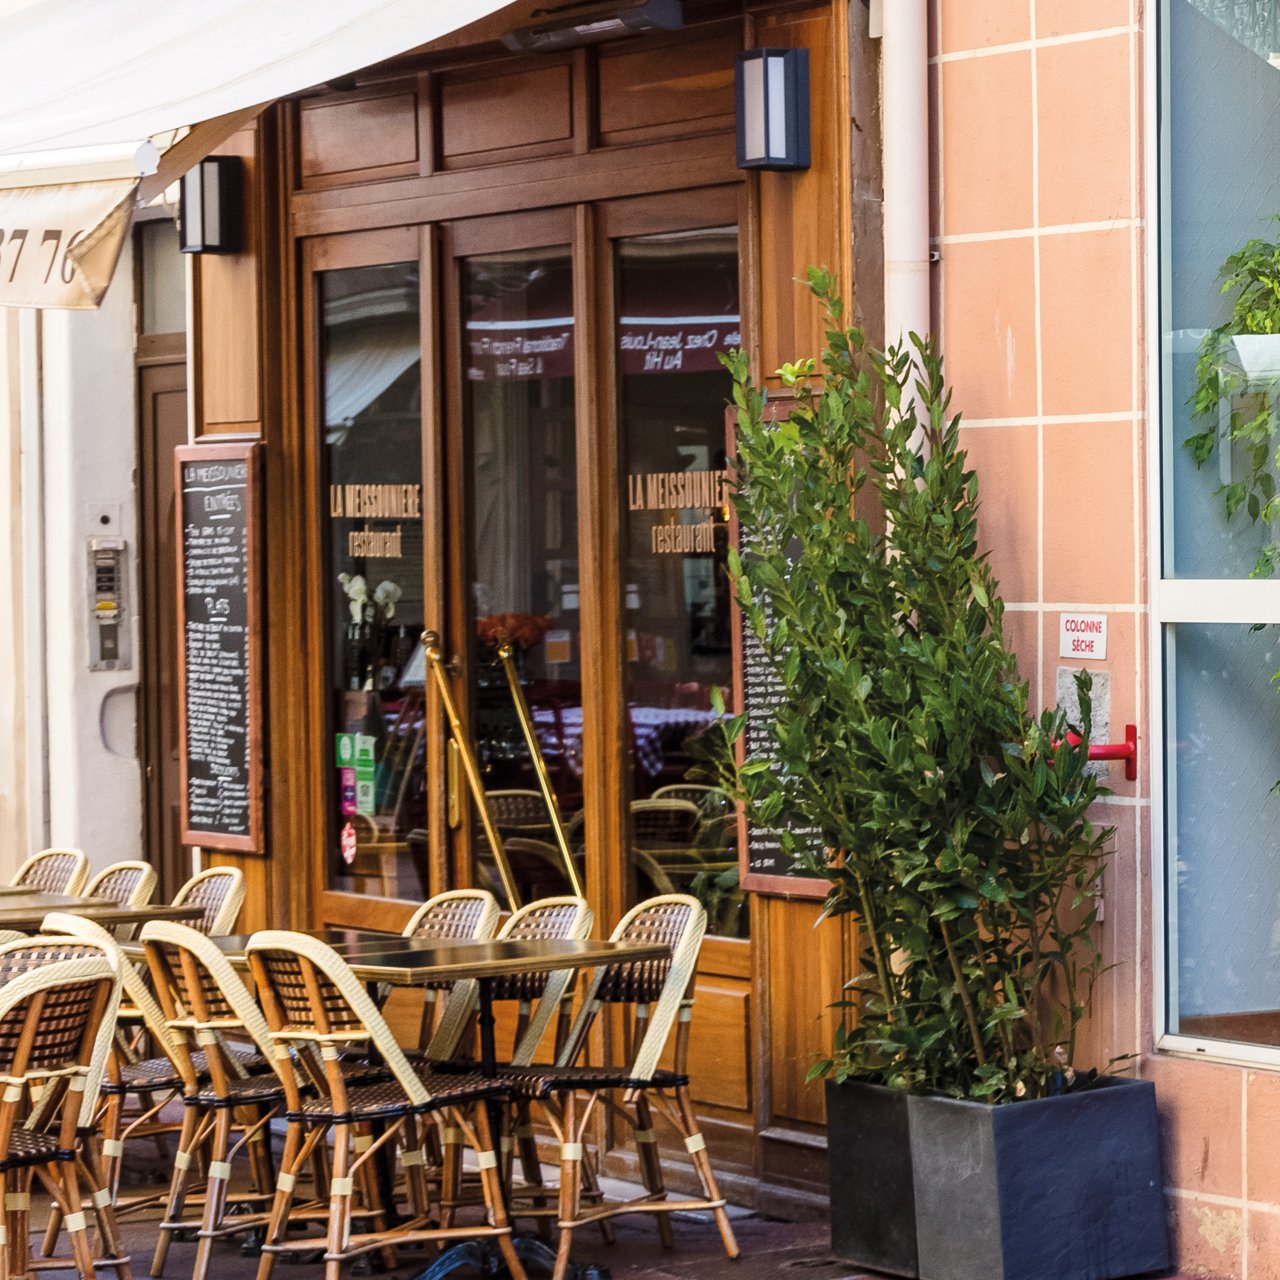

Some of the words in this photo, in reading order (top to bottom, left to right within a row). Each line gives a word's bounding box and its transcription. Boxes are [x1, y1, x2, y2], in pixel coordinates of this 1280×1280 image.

[0, 228, 29, 283] 7
[330, 484, 343, 517] LA
[628, 474, 644, 510] LA
[349, 524, 402, 557] restaurant
[652, 515, 716, 554] restaurant
[1065, 619, 1102, 633] COLONNE
[1072, 636, 1095, 653] SÈCHE
